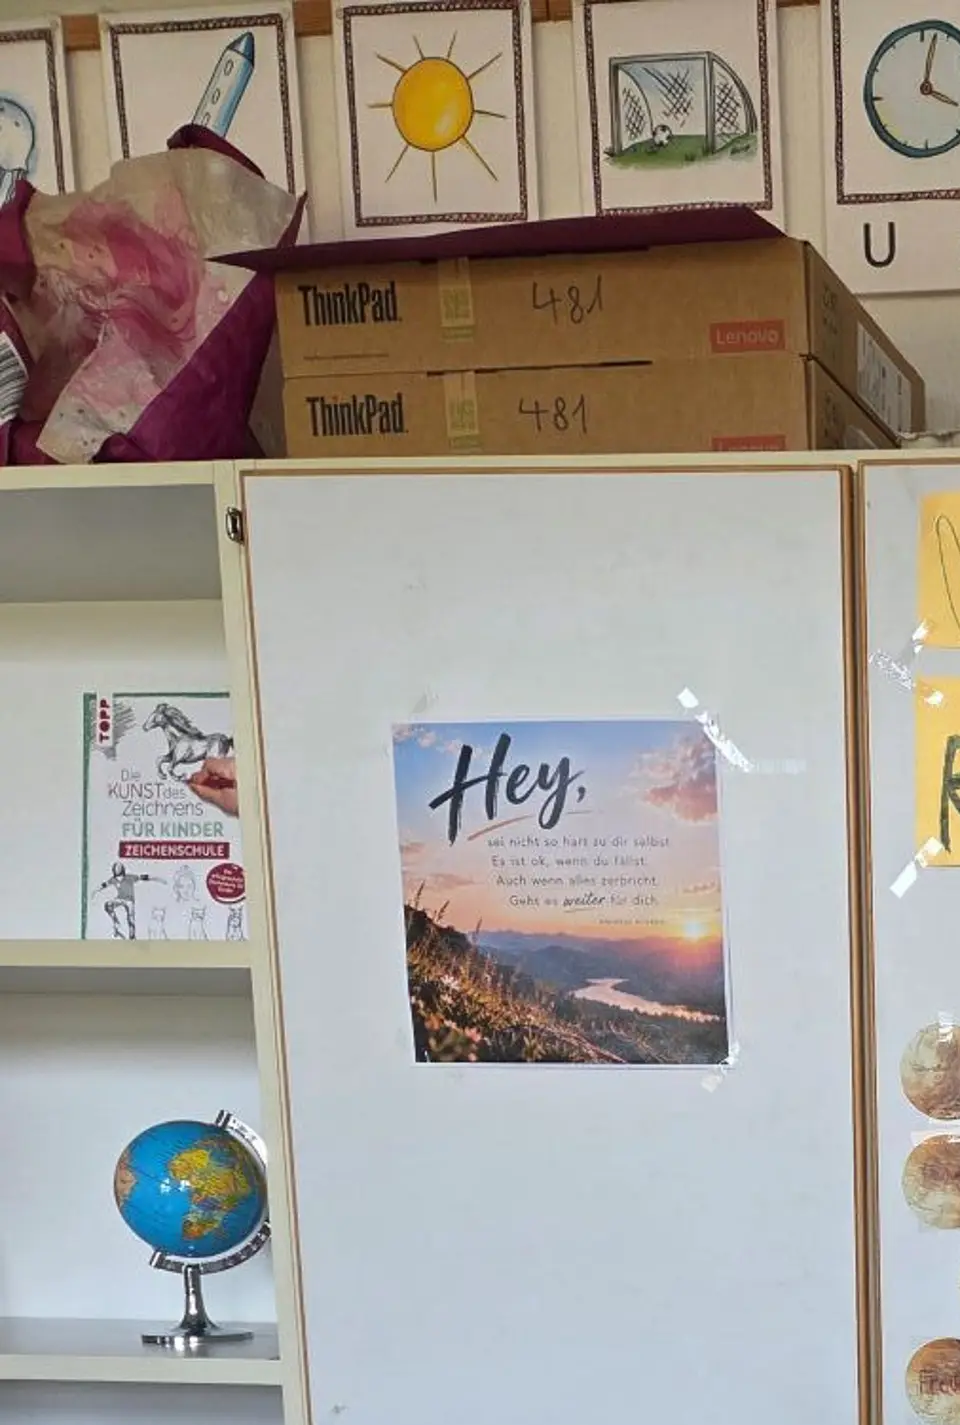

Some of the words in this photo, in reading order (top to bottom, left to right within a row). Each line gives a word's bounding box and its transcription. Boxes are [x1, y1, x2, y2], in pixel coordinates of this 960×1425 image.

[862, 224, 898, 267] U
[299, 281, 401, 328] ThinkPad
[531, 275, 604, 325] 481
[715, 327, 781, 347] Lenovo
[306, 392, 407, 438] ThinkPad
[518, 397, 589, 435] 481
[99, 699, 111, 743] TOPP
[121, 769, 141, 782] Die
[108, 783, 163, 799] KUNST
[163, 786, 186, 799] des
[429, 733, 587, 846] Hey,
[122, 800, 204, 818] Zeichnens
[122, 818, 155, 838] FÜR
[160, 821, 225, 838] KINDER
[124, 844, 225, 857] ZEICHENSCHULE
[509, 836, 540, 848] nicht
[544, 838, 558, 848] so
[563, 836, 588, 848] hart
[612, 836, 628, 848] dir
[634, 836, 670, 848] selbst
[491, 855, 505, 867] Es
[510, 856, 525, 867] ist
[556, 858, 589, 867] wenn
[594, 856, 609, 867] du
[496, 875, 526, 886] Auch
[531, 877, 563, 886] wenn
[569, 875, 596, 886] alles
[509, 894, 540, 906] Geht
[563, 892, 606, 908] weiter
[610, 894, 628, 906] für
